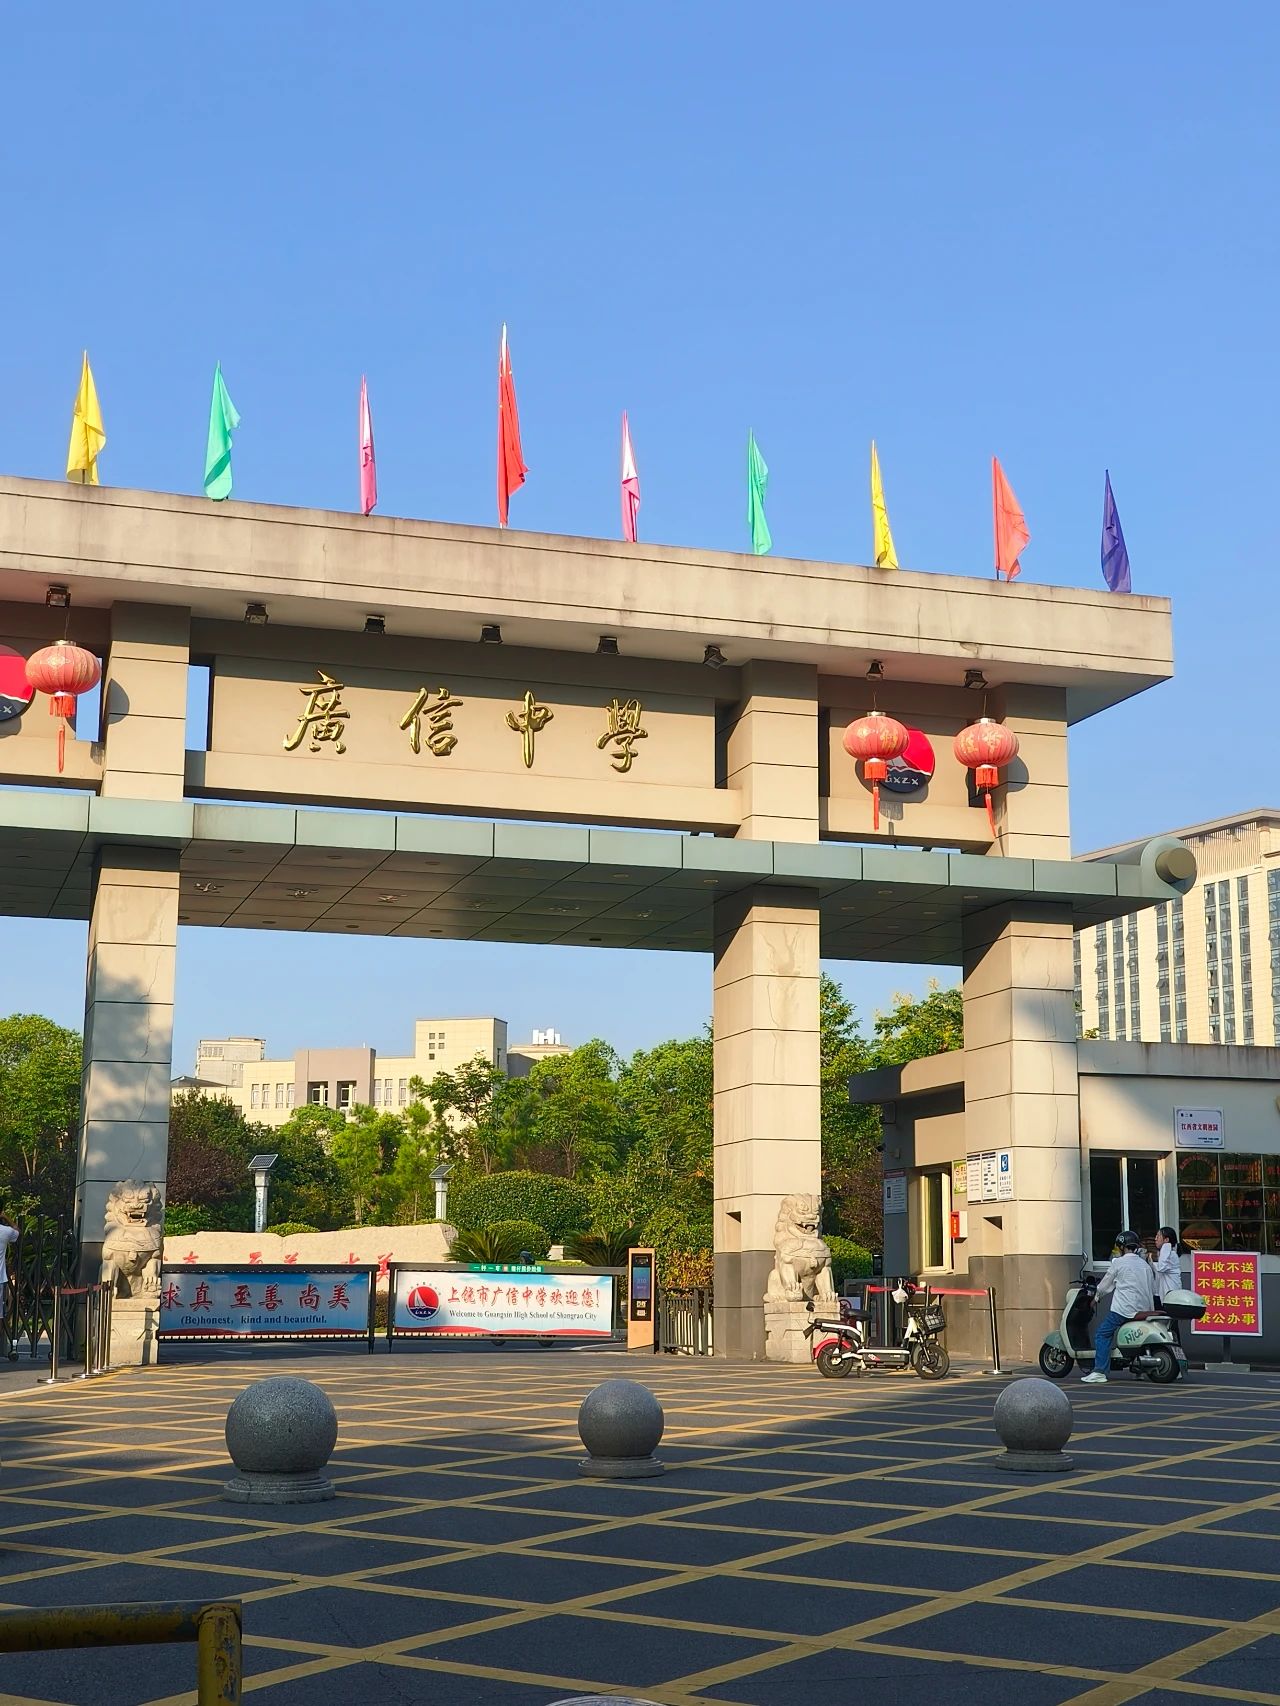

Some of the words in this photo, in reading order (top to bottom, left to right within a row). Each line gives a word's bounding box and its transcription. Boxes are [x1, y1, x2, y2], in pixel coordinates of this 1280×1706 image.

[282, 669, 648, 774] 廣信中學
[1197, 1261, 1255, 1273] 不收不送
[1197, 1278, 1255, 1290] 不攀不靠
[161, 1281, 213, 1312] 求真
[230, 1282, 283, 1312] 至善
[299, 1282, 350, 1311] 尚美
[241, 1315, 262, 1324] kind
[264, 1315, 282, 1324] and
[284, 1315, 327, 1324] beautiful.
[449, 1310, 476, 1318] Welcome
[484, 1310, 513, 1320] Guangxin
[514, 1310, 528, 1320] High
[529, 1311, 549, 1319] School
[550, 1311, 555, 1319] of
[556, 1311, 584, 1320] Shangrao
[585, 1311, 597, 1321] City
